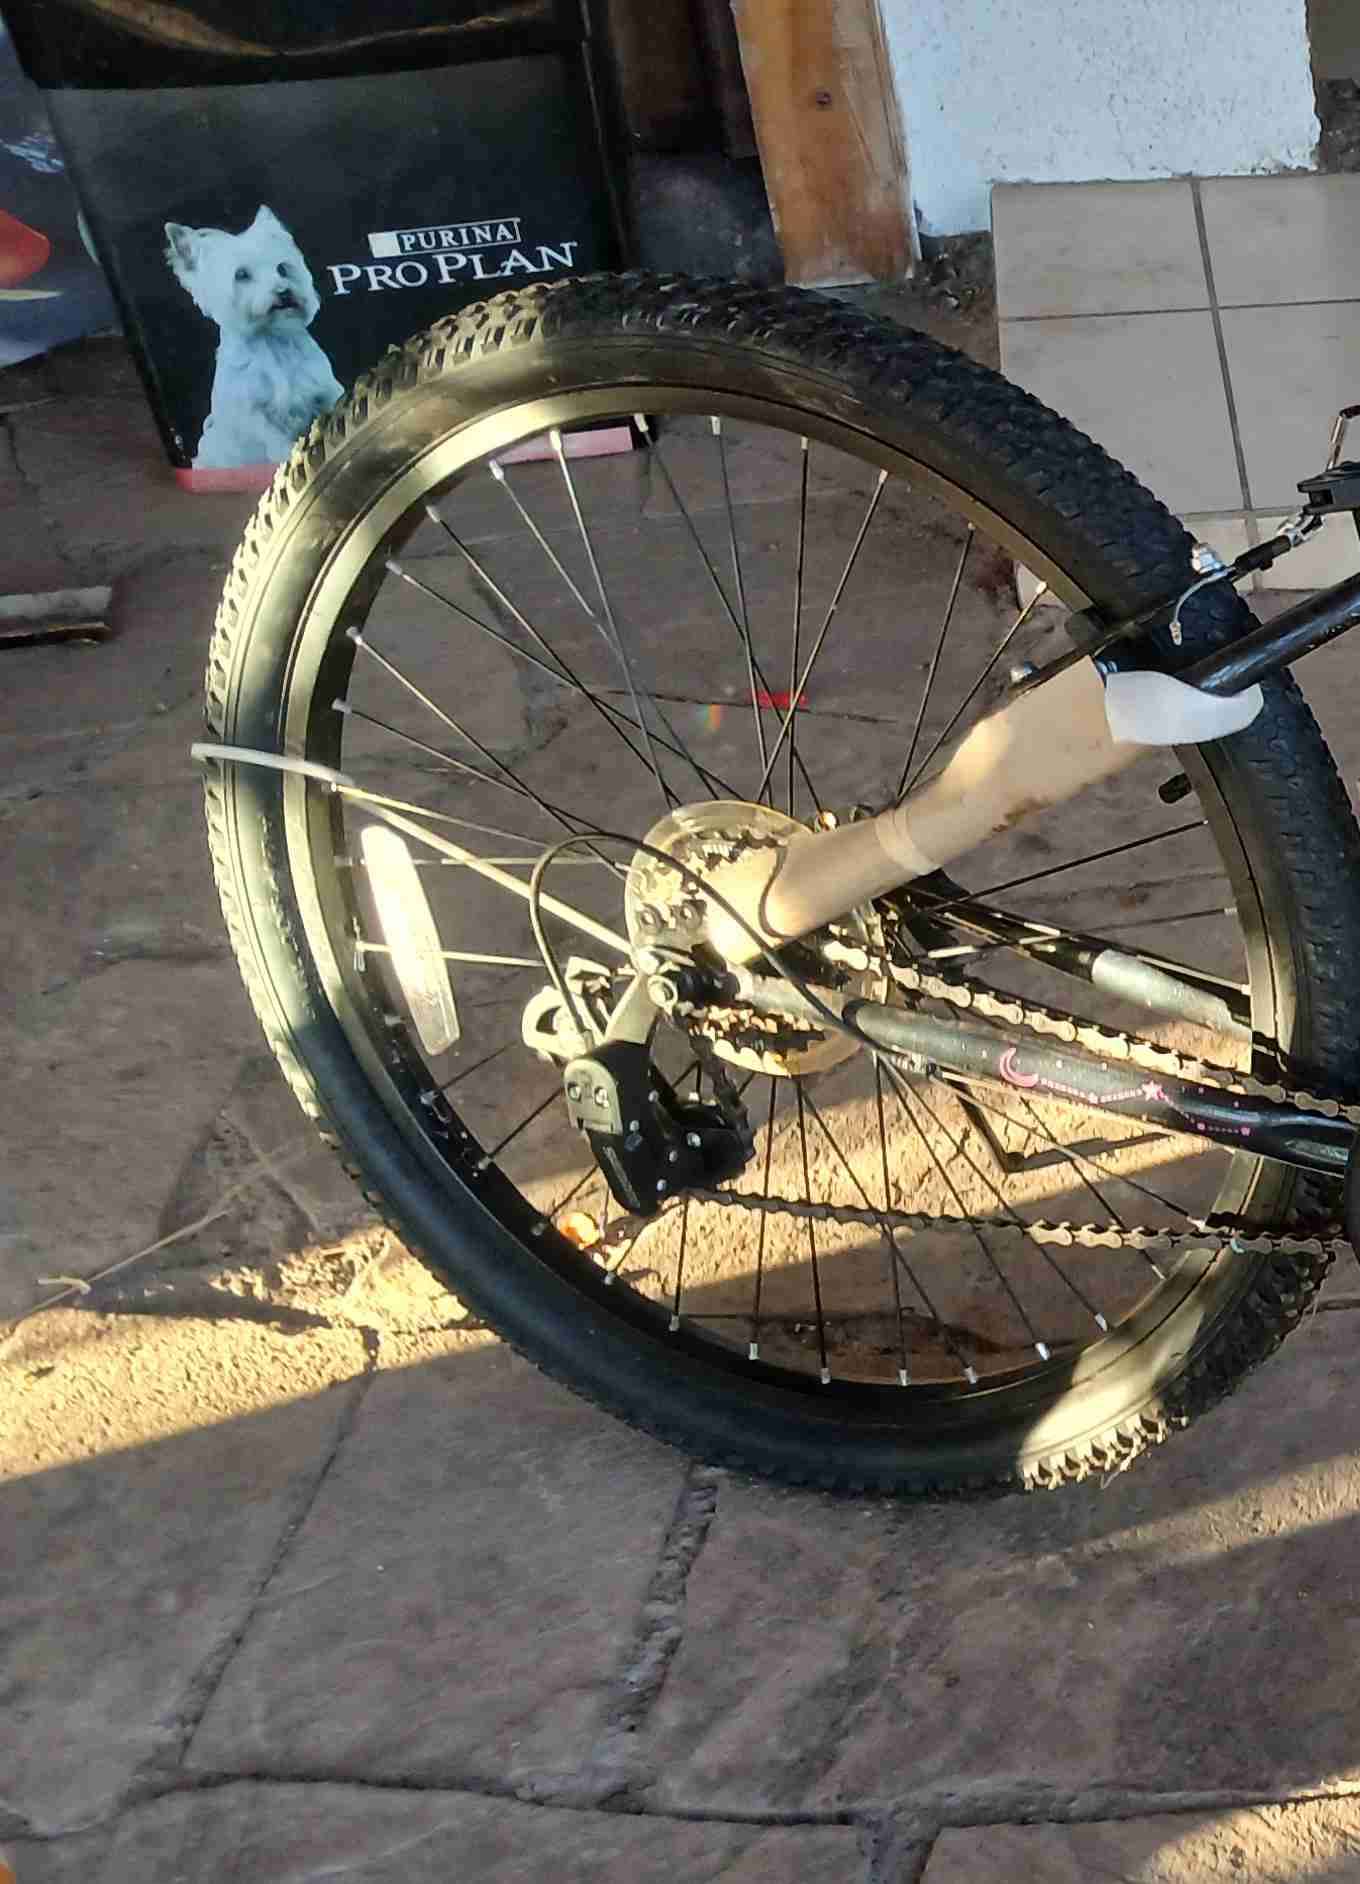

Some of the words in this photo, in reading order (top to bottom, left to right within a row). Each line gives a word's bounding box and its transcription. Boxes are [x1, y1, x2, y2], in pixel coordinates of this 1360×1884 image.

[400, 223, 515, 251] PURINA
[327, 261, 429, 296] PRO
[432, 241, 577, 285] PLAN
